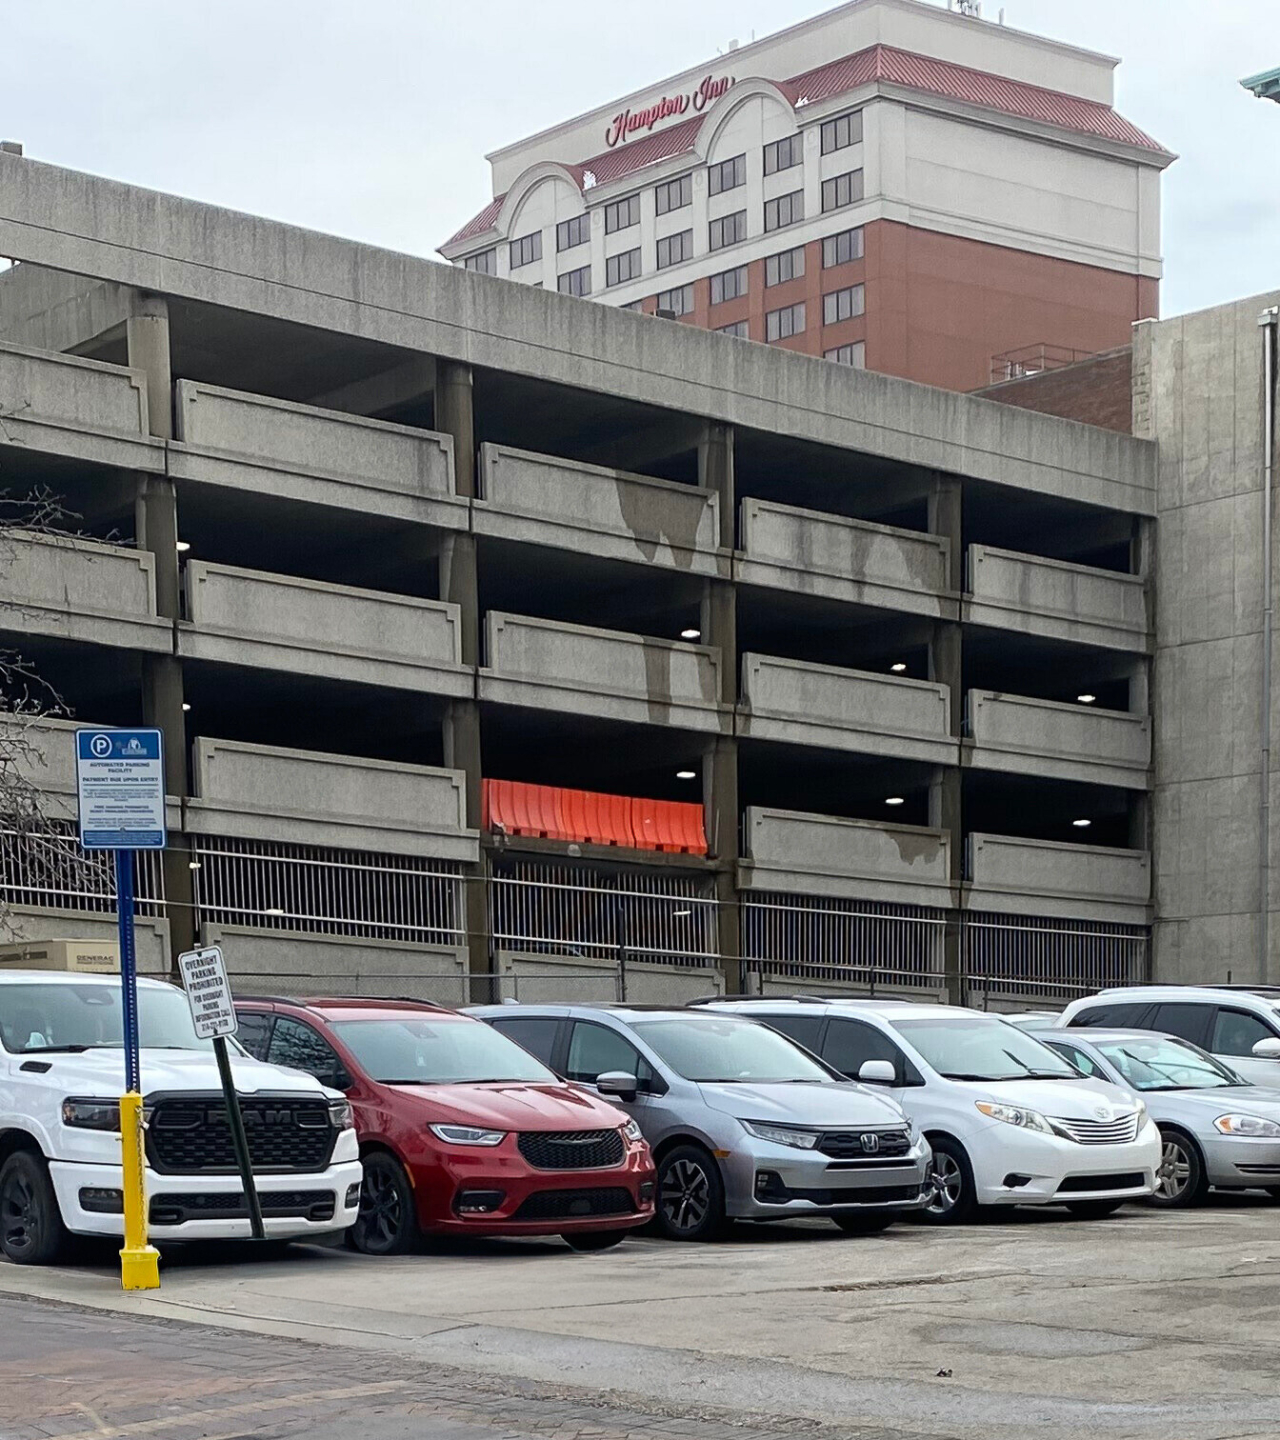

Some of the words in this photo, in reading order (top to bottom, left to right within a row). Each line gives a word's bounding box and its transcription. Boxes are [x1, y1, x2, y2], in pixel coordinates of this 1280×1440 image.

[606, 95, 690, 147] Hampton
[693, 75, 735, 112] Inn
[185, 955, 218, 971] OVERNIGHT
[191, 967, 217, 980] PARKING
[189, 977, 223, 992] PROHIBITED
[206, 1110, 291, 1124] RAM
